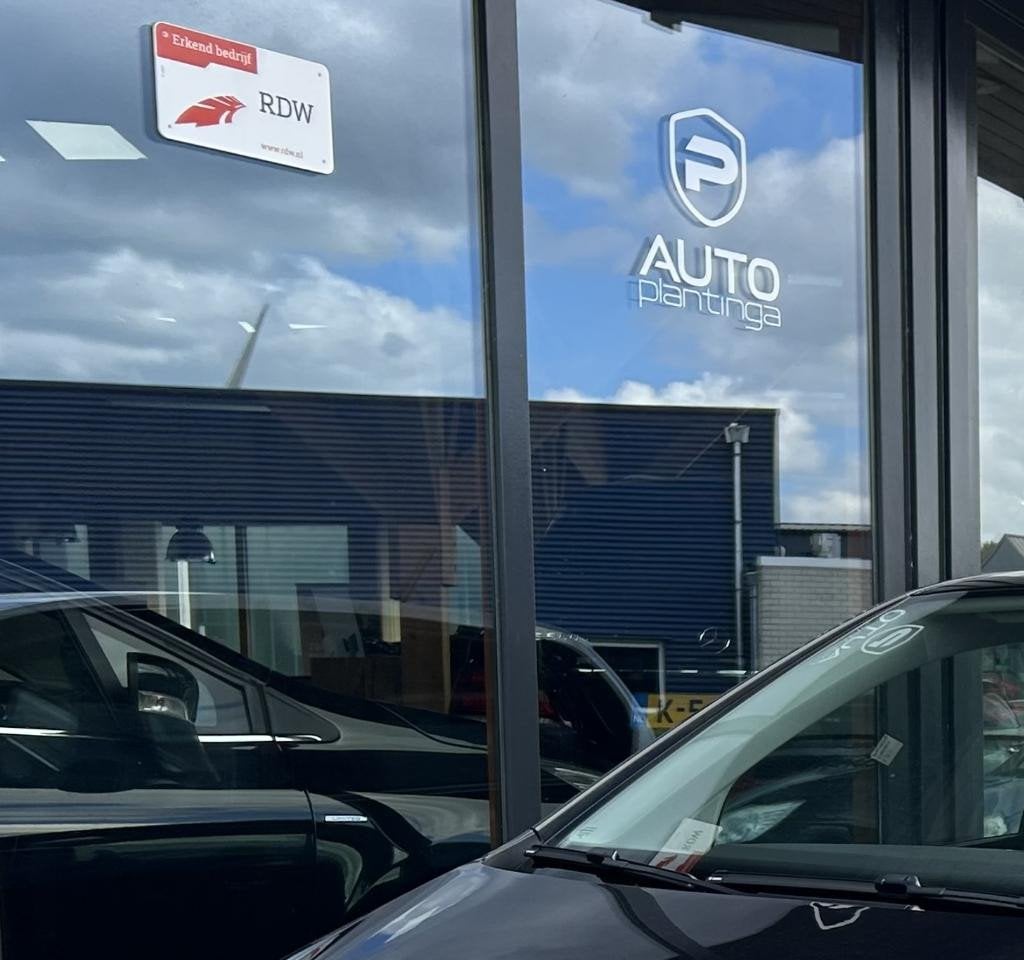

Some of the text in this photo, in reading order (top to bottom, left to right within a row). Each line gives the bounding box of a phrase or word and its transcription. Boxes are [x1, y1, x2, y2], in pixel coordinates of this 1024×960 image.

[171, 33, 252, 66] Erkend bedrijf
[258, 91, 314, 124] RDW
[639, 233, 781, 302] AUTO
[638, 277, 782, 332] plantinga
